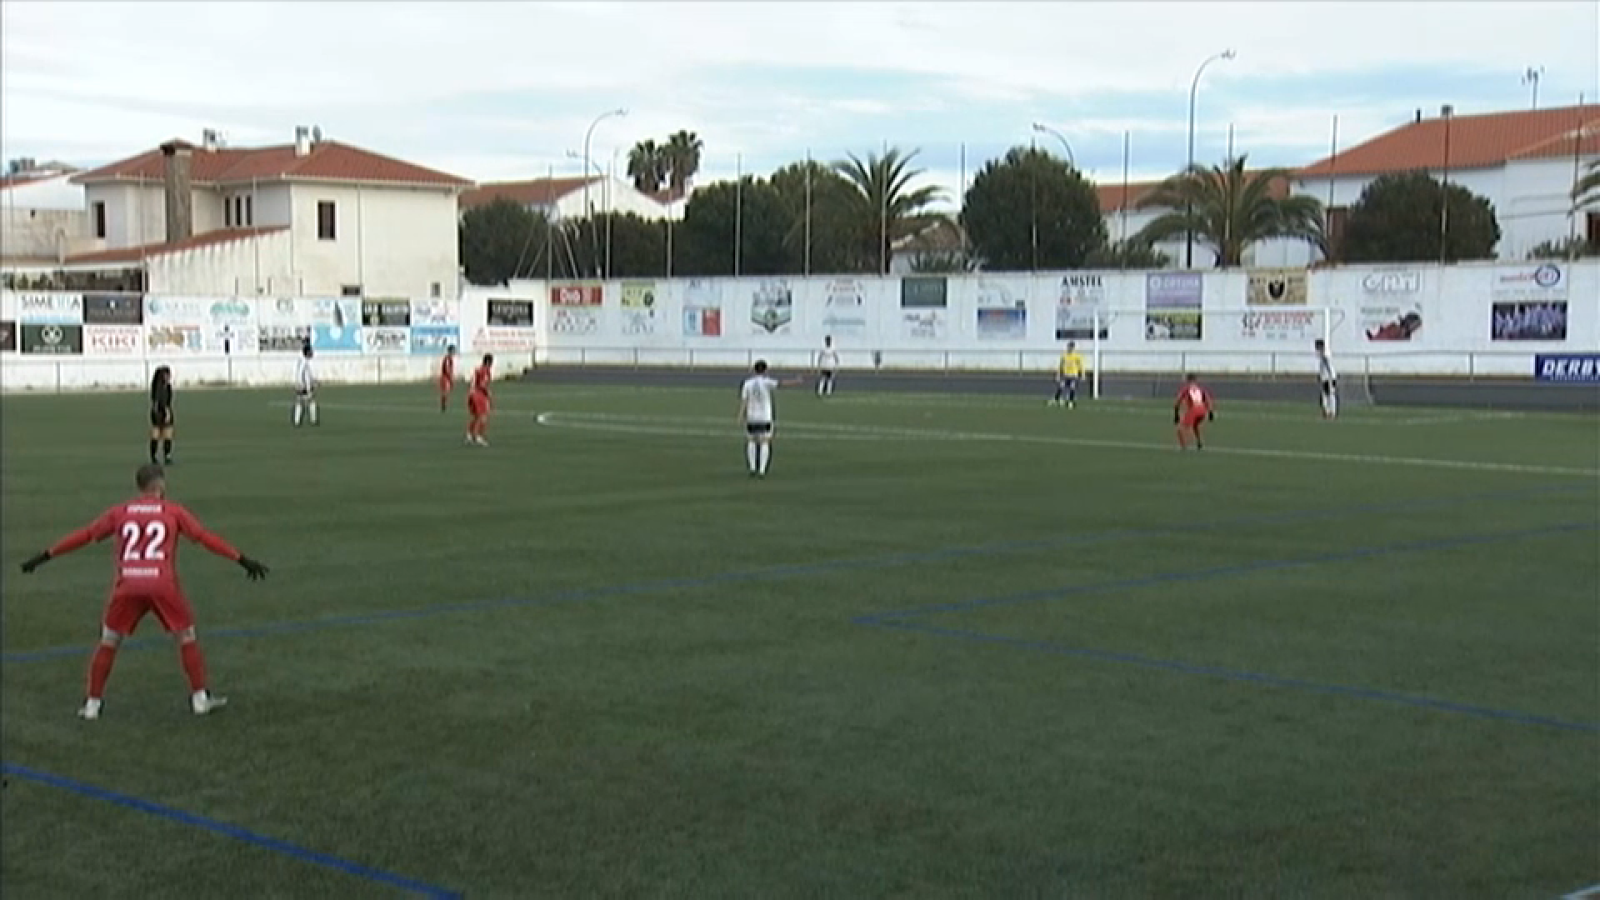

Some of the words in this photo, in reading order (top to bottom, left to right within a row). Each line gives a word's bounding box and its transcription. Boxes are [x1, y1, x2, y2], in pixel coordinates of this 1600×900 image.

[1062, 274, 1103, 287] AMSTEL
[92, 334, 136, 347] KIKI
[122, 520, 166, 560] 22
